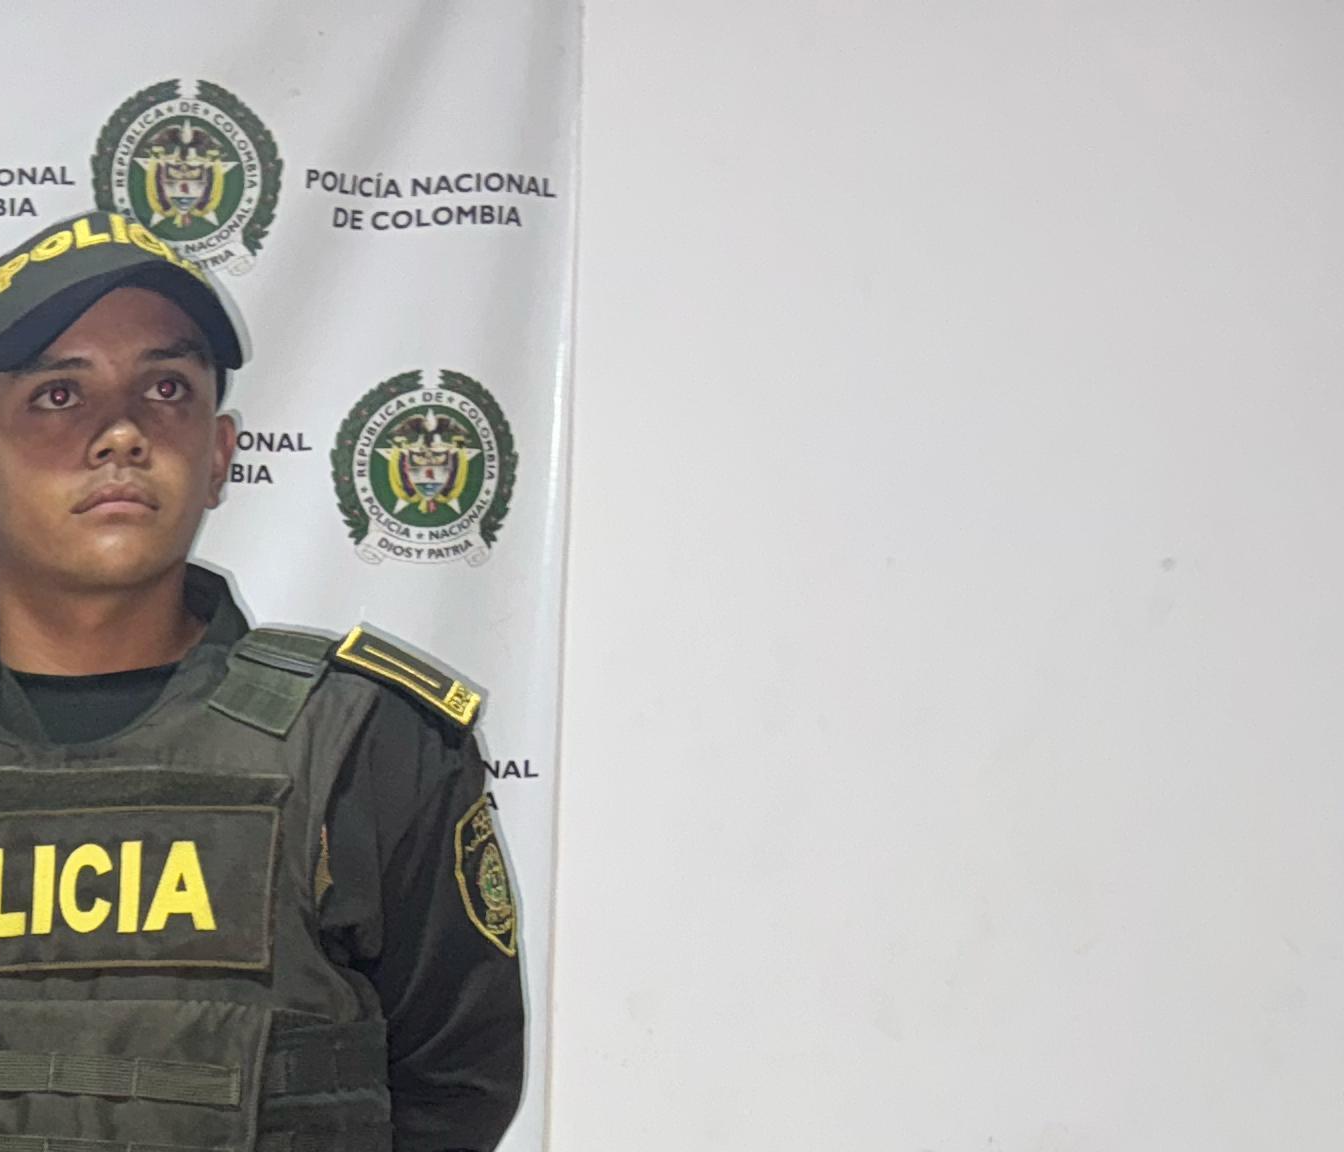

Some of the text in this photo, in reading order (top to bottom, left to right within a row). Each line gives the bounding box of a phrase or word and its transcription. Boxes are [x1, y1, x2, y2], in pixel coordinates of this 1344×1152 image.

[178, 104, 199, 116] DE
[212, 112, 257, 191] COLOMBIA
[305, 168, 557, 199] POLICÍA NACIONAL
[186, 206, 251, 253] NACIONAL
[332, 204, 523, 231] DE COLOMBIA
[422, 392, 443, 404] DE
[455, 400, 498, 479] COLOMBIA
[426, 494, 492, 541] NACIONAL
[425, 540, 474, 561] PATRIA
